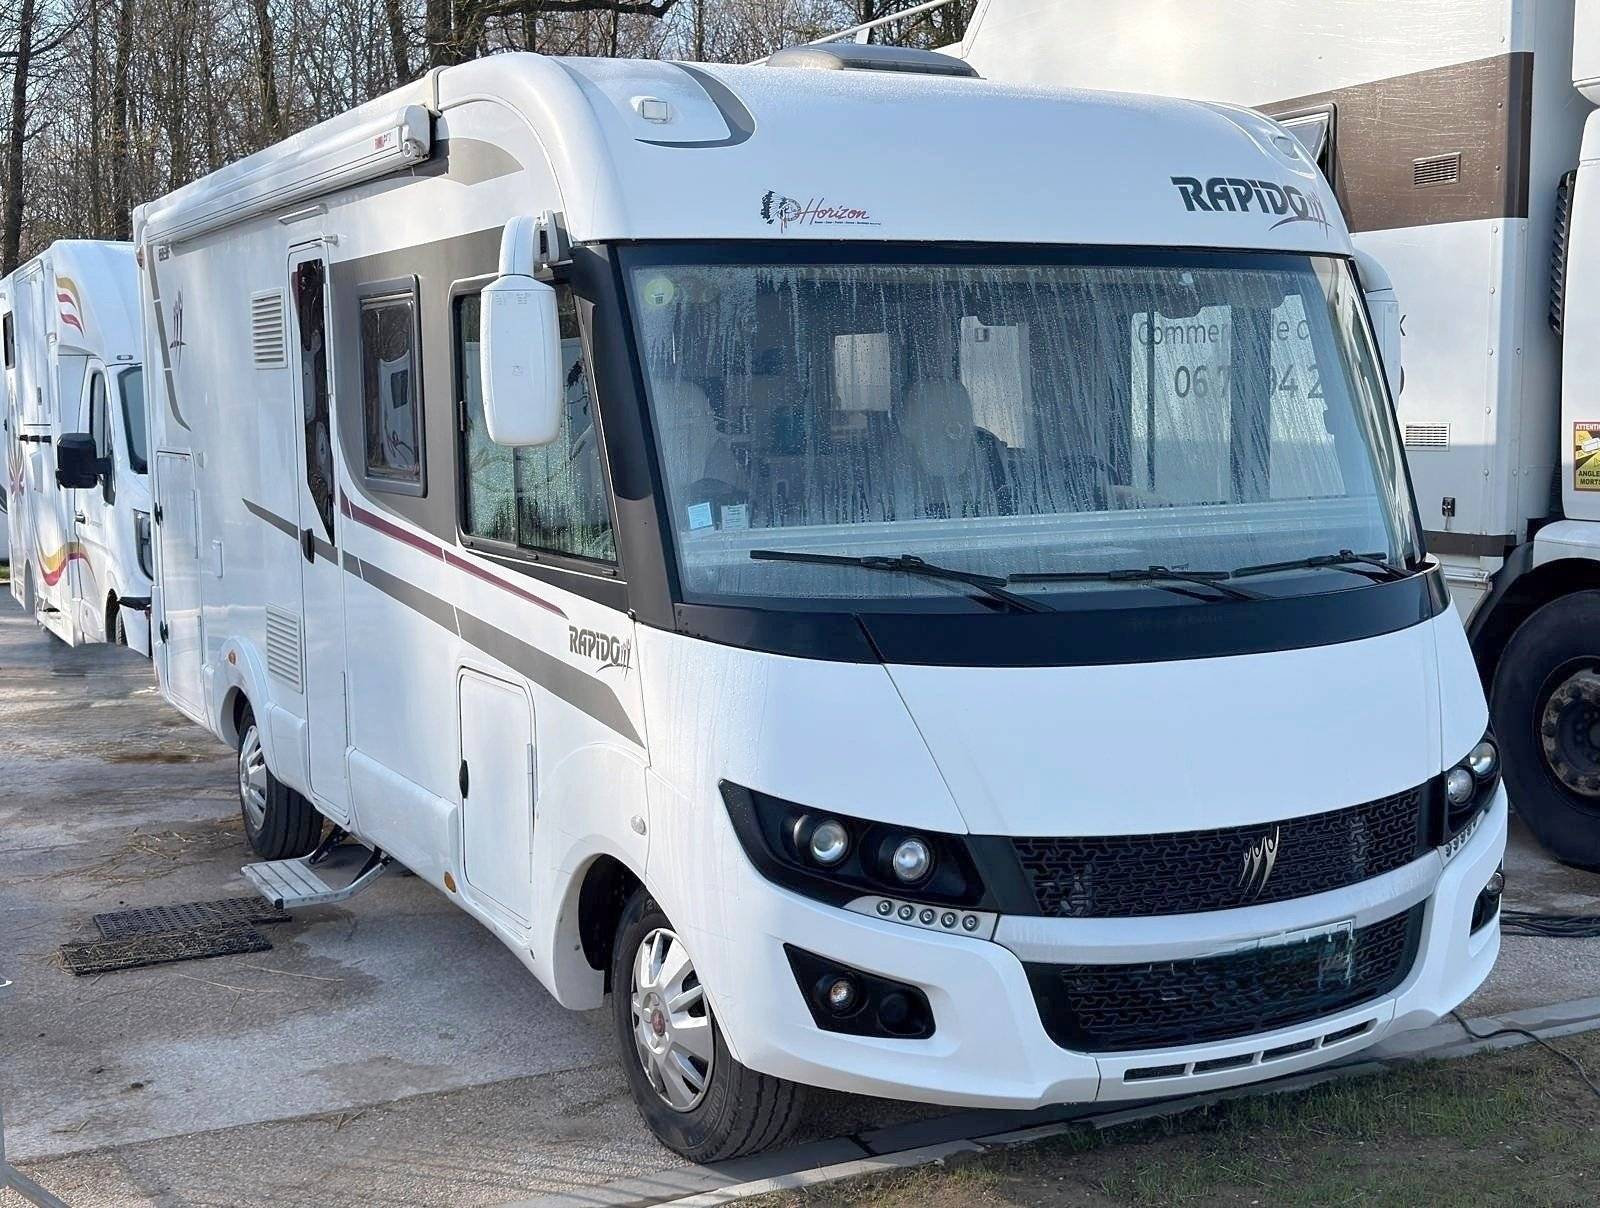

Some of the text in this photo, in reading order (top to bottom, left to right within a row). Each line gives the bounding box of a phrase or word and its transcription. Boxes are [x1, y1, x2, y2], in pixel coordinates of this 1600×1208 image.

[799, 197, 870, 225] Horizon
[1138, 321, 1231, 345] Commer
[1174, 364, 1208, 398] 06
